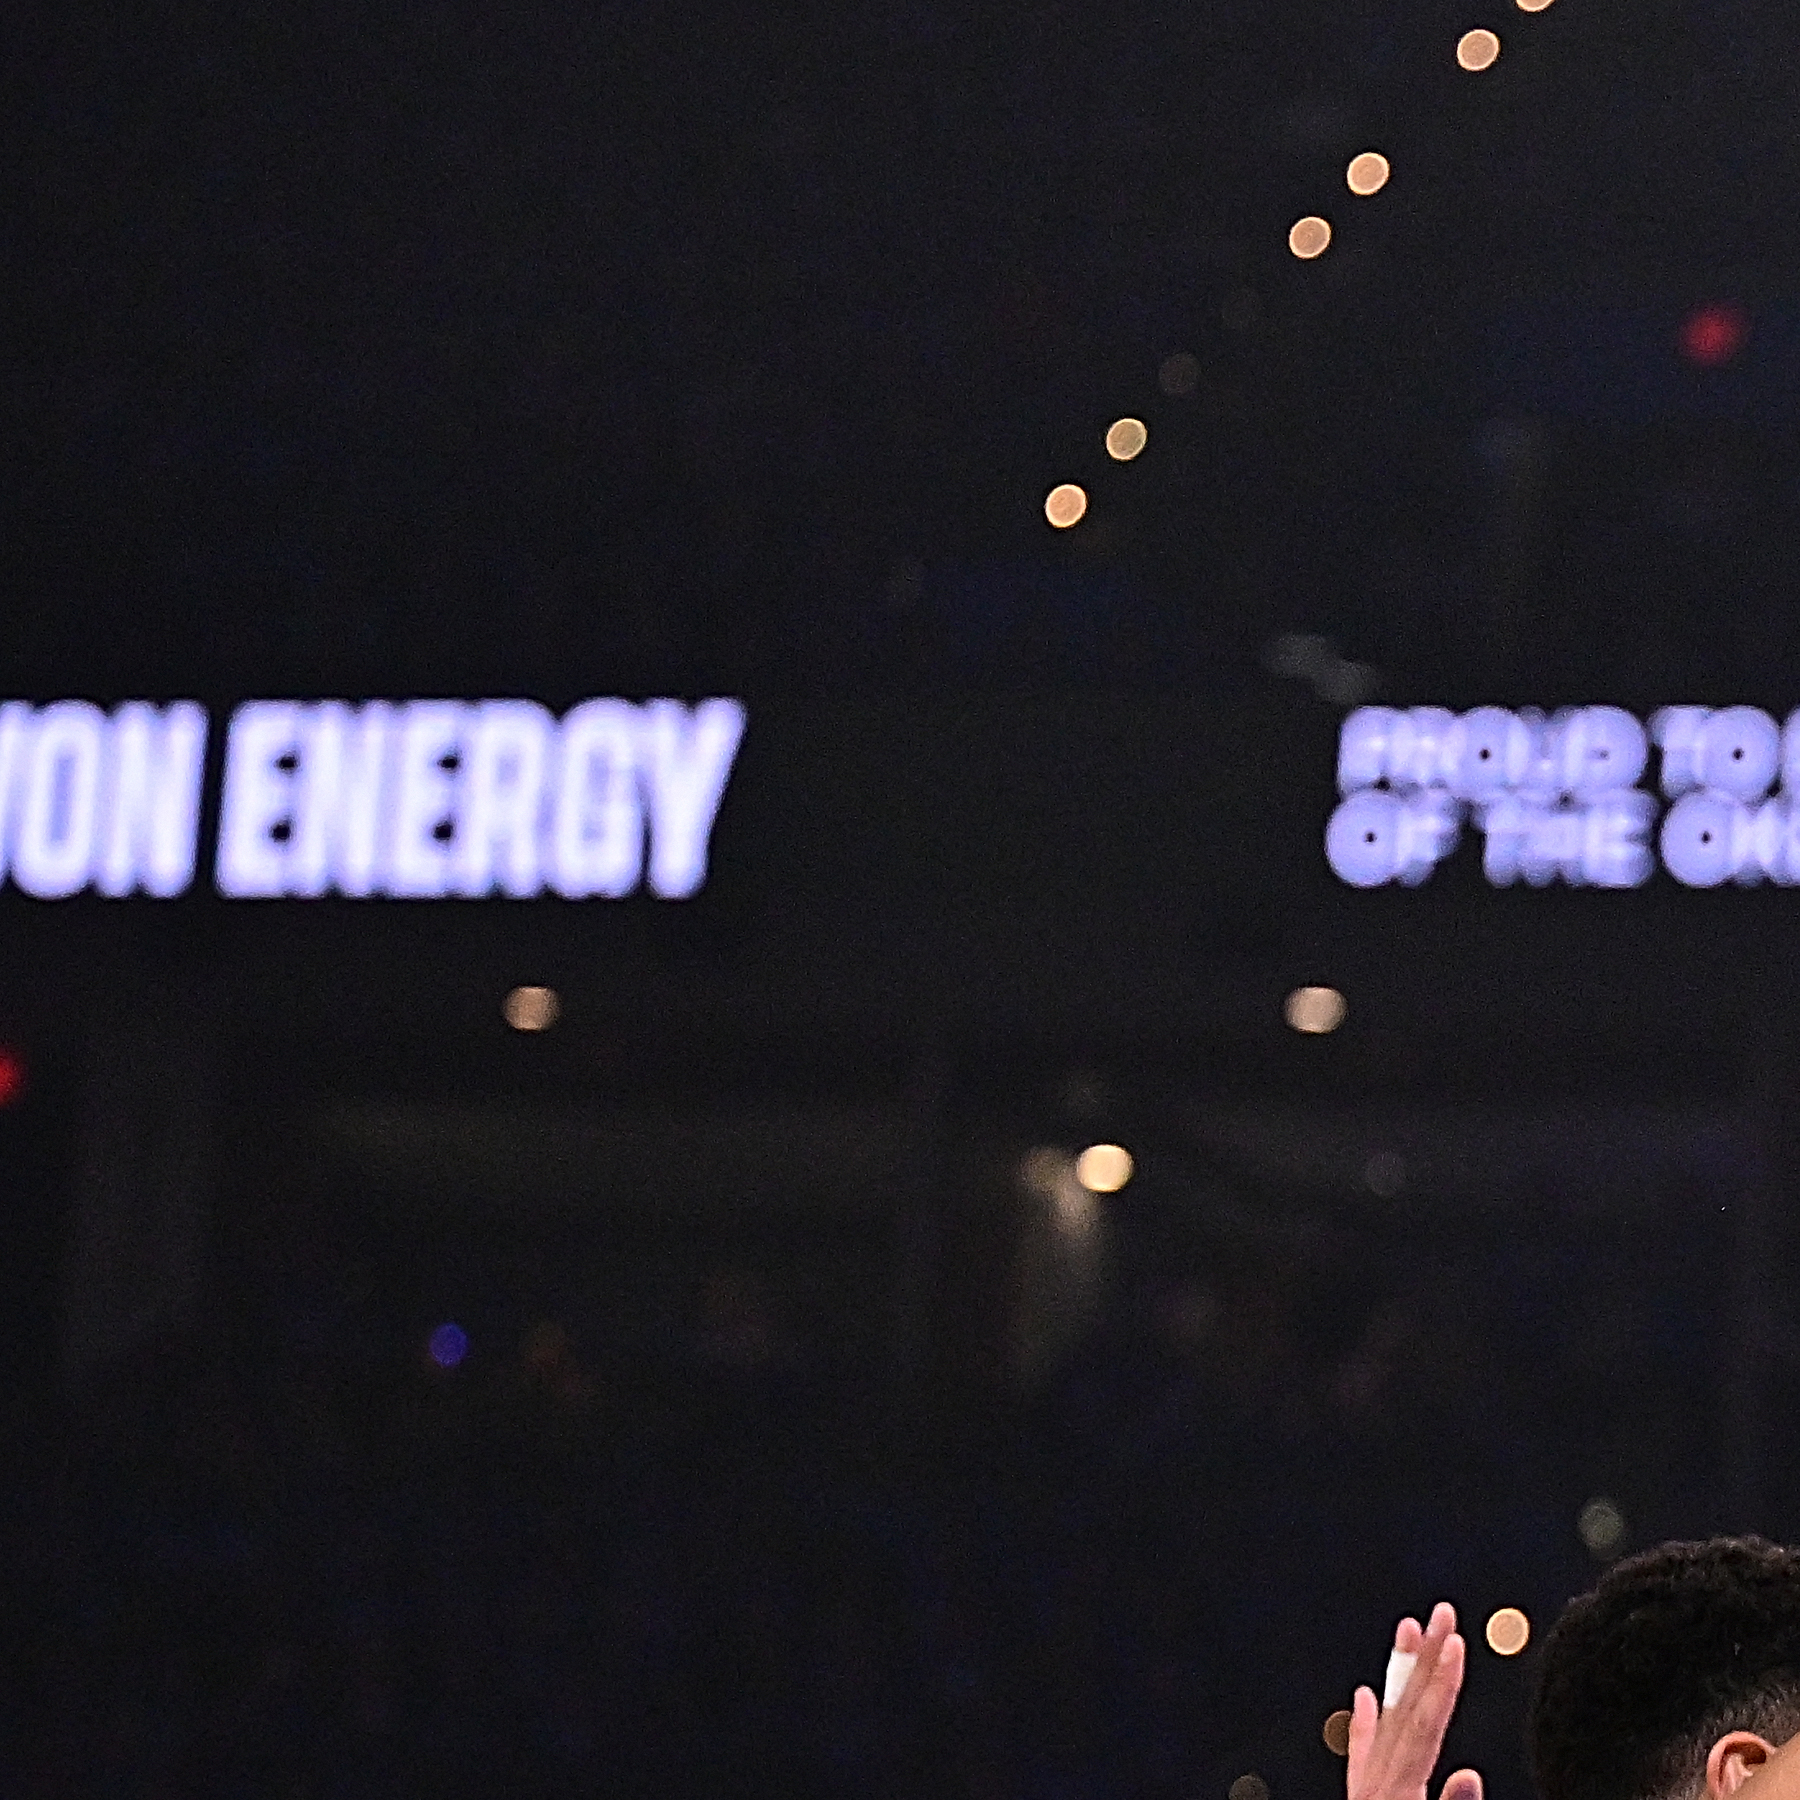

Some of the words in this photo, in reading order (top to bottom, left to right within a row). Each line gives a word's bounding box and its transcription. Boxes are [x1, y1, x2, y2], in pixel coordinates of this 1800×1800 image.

[214, 696, 747, 900] ENERGY
[1648, 704, 1780, 797] TO
[1325, 788, 1462, 888] OF
